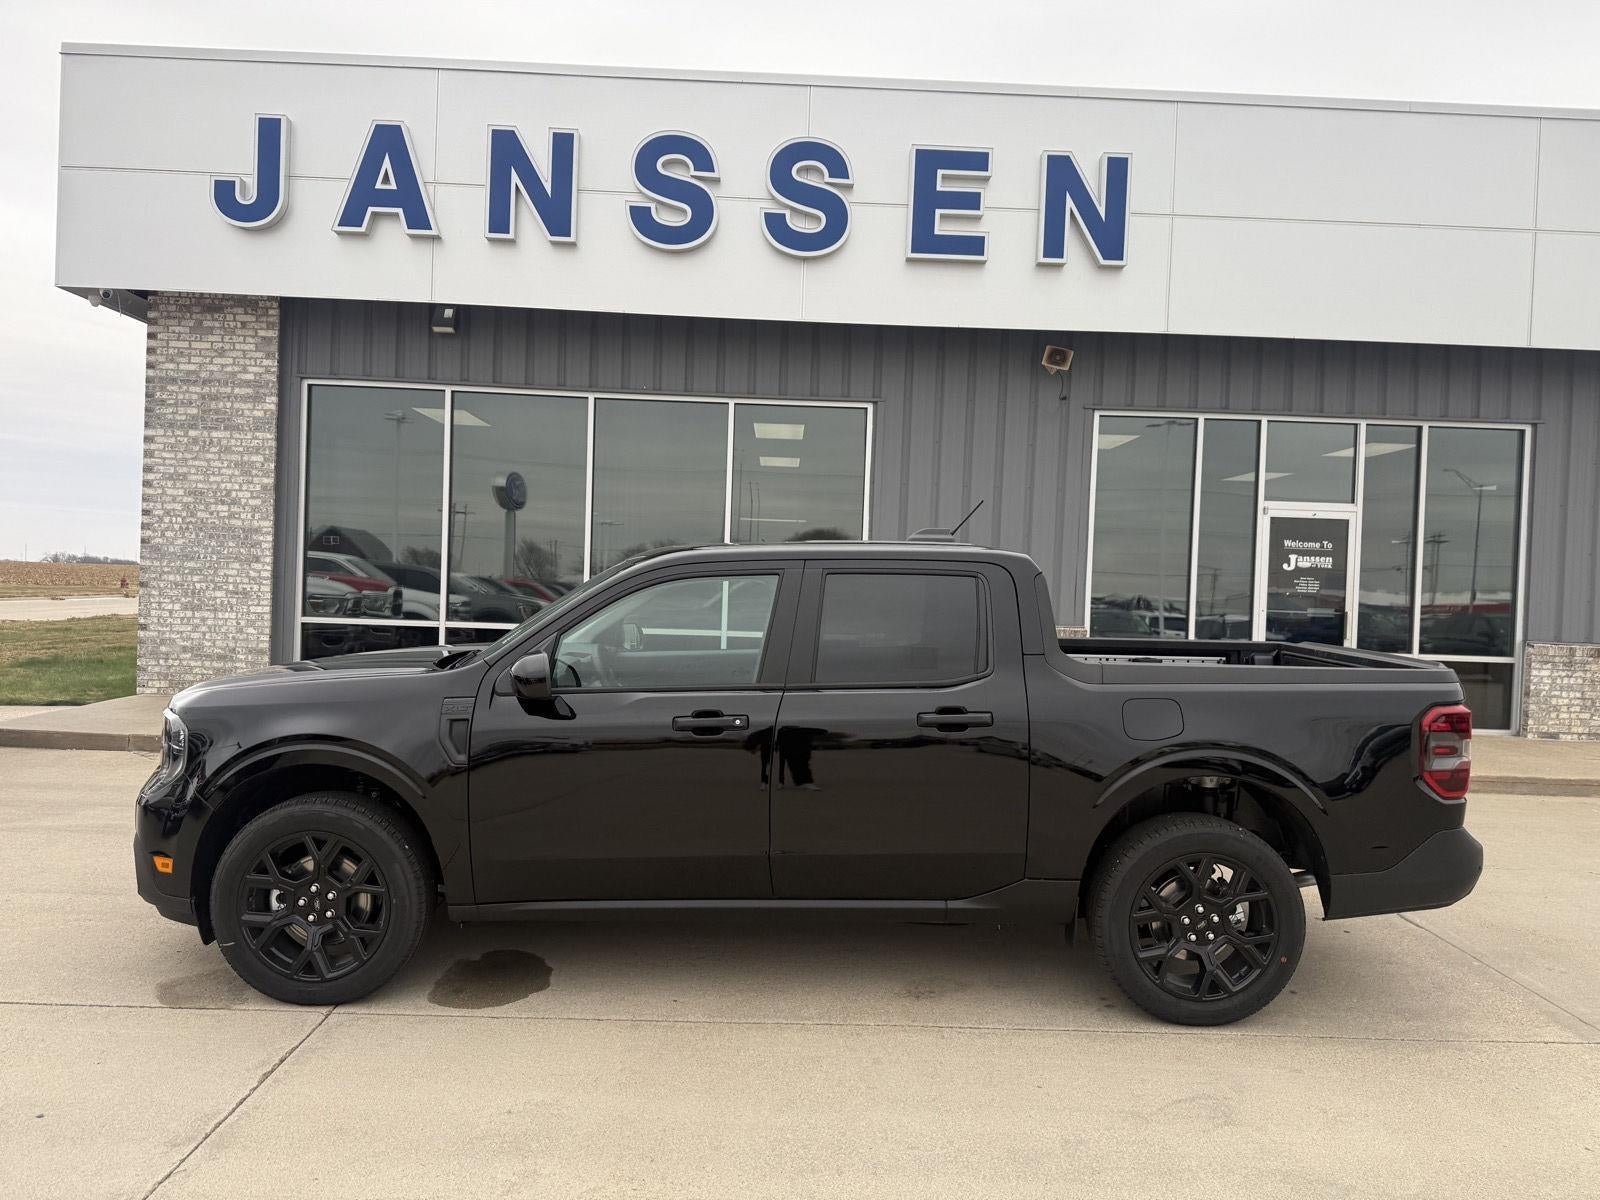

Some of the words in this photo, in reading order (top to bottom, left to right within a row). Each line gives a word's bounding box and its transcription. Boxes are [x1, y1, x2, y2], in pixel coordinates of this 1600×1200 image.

[211, 113, 1132, 269] JANSSEN
[1283, 539, 1321, 549] Welcome
[1322, 540, 1333, 549] To
[1282, 554, 1333, 570] Janssen
